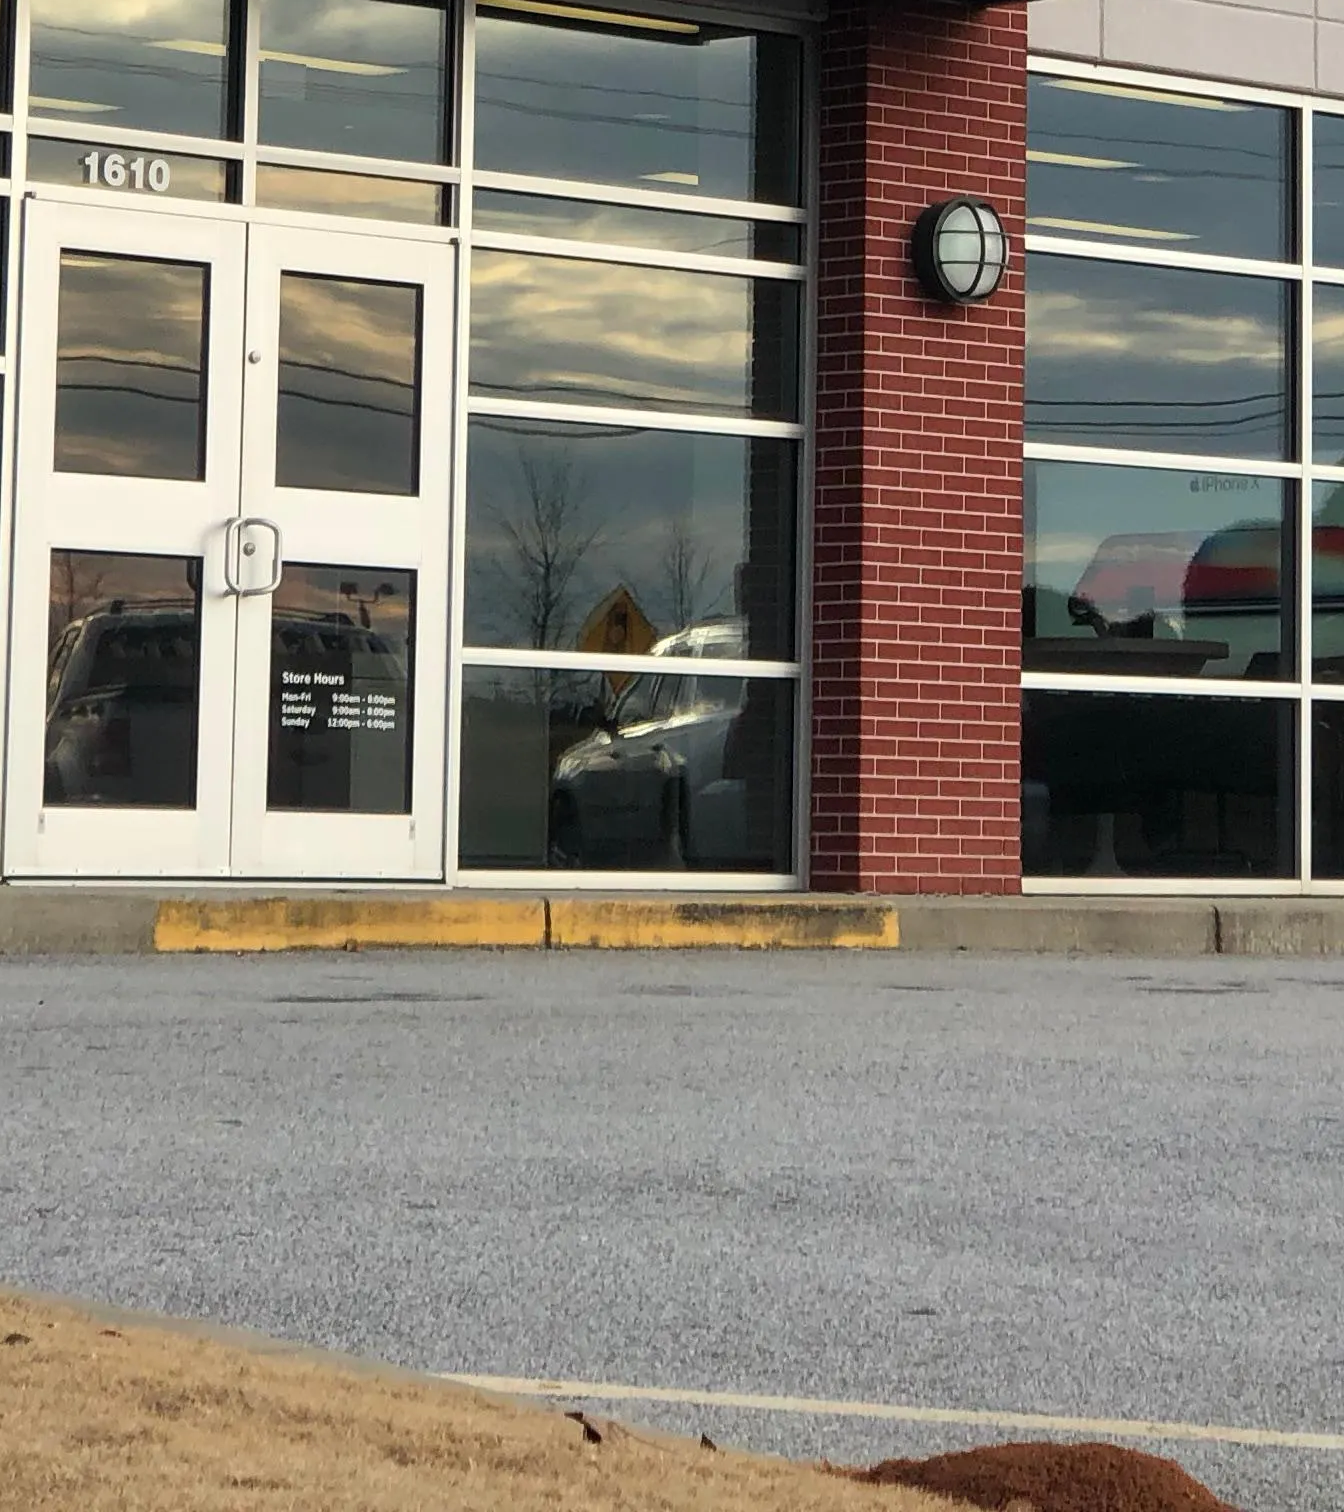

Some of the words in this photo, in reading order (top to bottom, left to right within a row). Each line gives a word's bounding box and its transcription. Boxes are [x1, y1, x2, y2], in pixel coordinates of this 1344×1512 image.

[84, 151, 170, 192] 1610
[1202, 475, 1248, 492] iPhone
[282, 671, 311, 685] Store
[314, 673, 345, 686] Hours
[281, 692, 312, 702] Mon-Fri
[332, 693, 361, 703] 9:00am
[281, 705, 317, 717] Saturday
[281, 717, 310, 729] Sunday
[327, 718, 360, 730] 12:00pm
